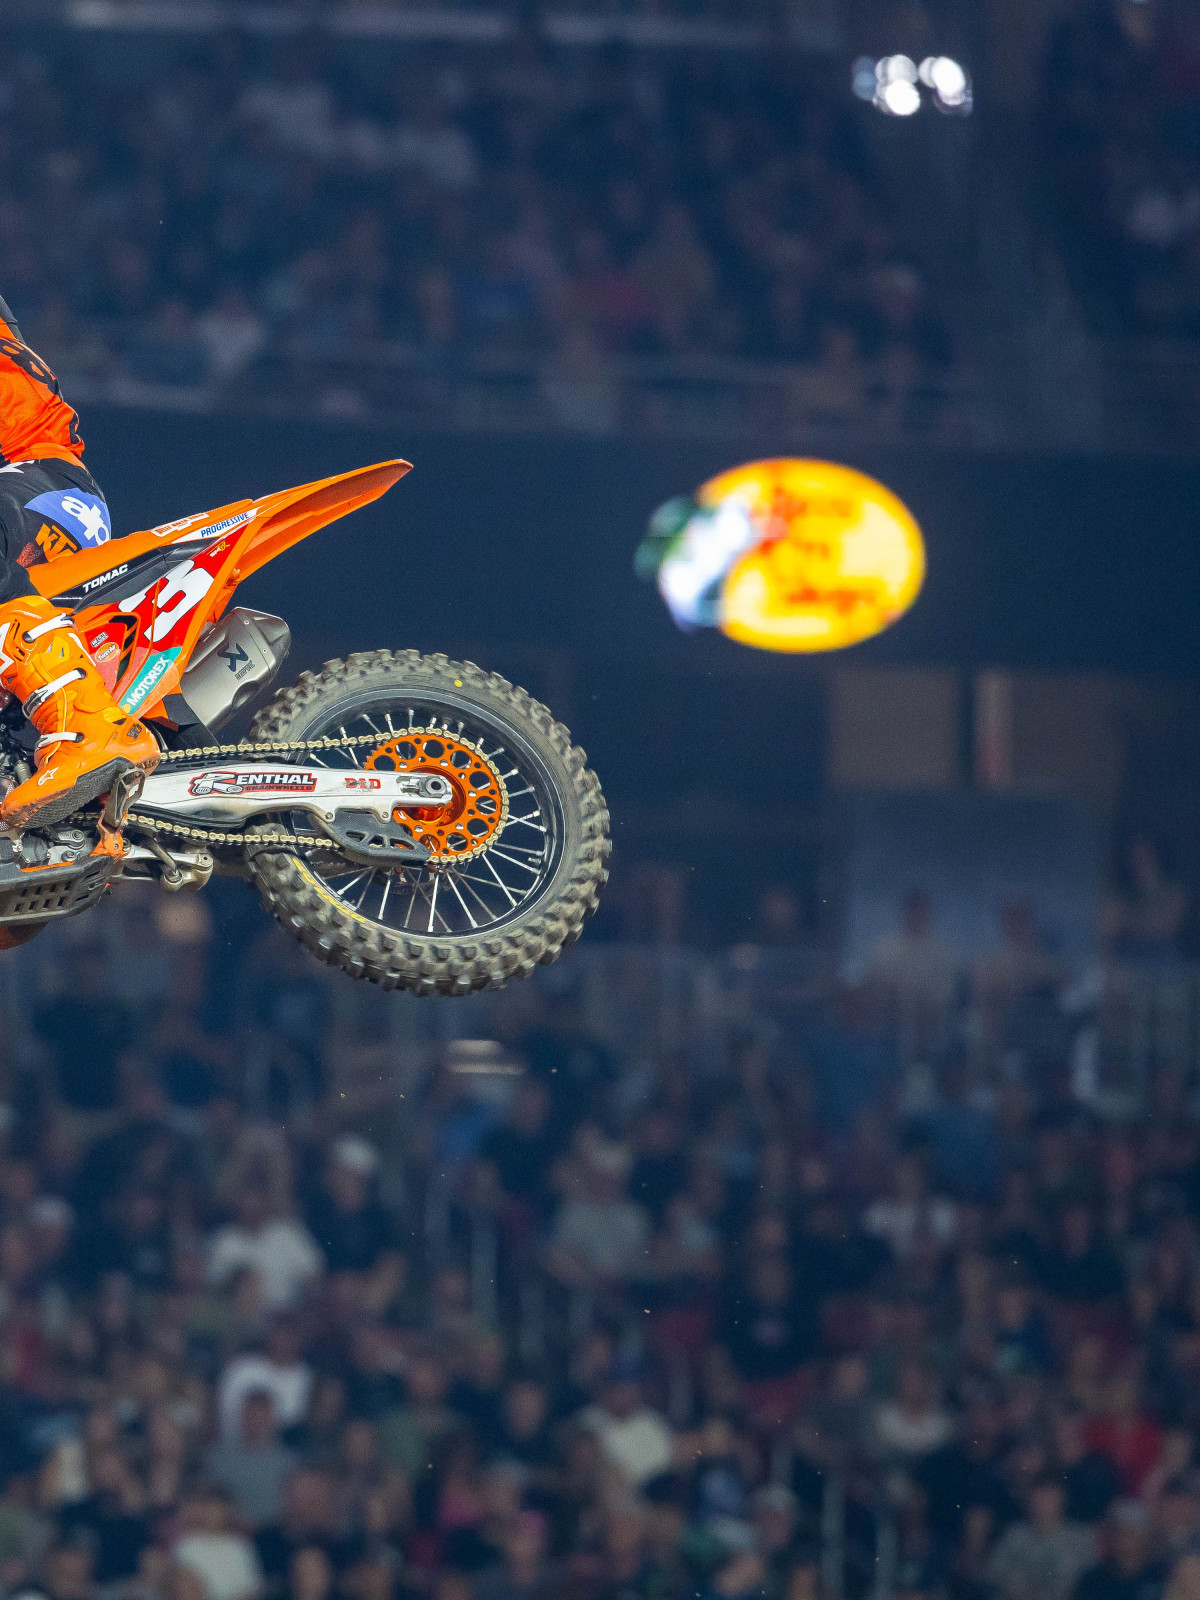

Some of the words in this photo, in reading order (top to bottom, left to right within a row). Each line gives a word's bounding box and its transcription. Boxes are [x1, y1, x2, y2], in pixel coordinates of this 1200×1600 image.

[201, 512, 249, 538] PROGRESSIVE
[82, 564, 129, 593] TOMAC
[118, 560, 215, 643] 3
[126, 657, 169, 706] MOTOREX
